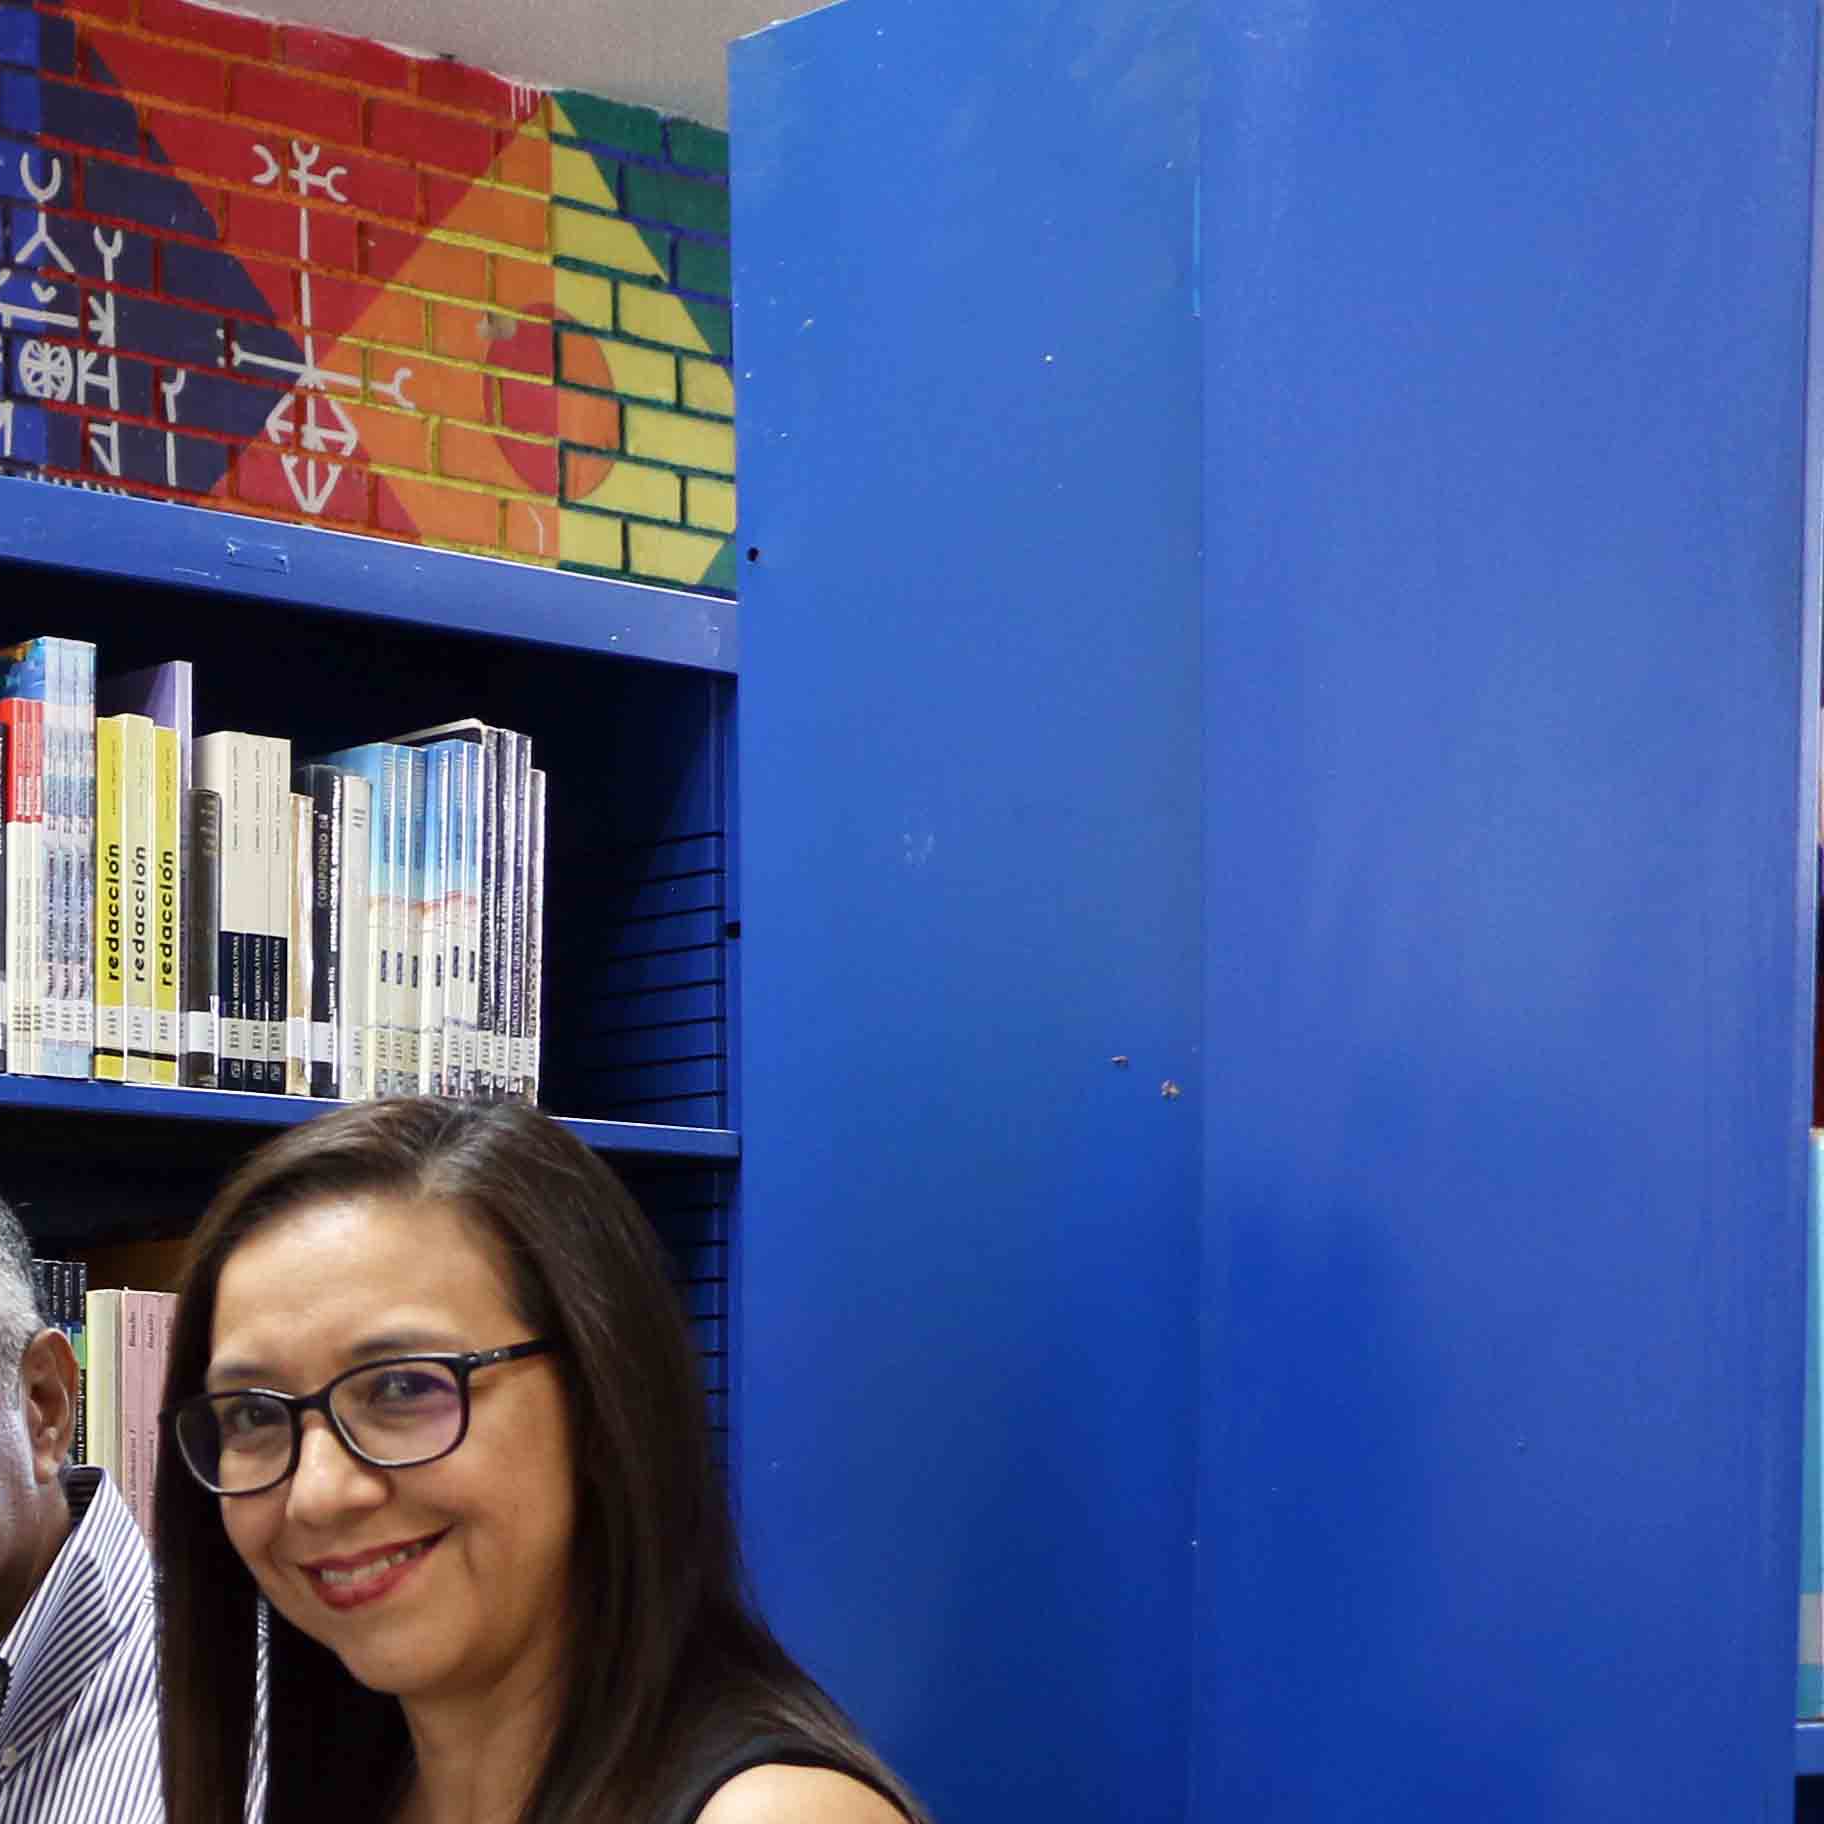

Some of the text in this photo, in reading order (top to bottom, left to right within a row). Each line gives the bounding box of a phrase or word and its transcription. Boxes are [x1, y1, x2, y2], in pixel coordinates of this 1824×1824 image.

[317, 832, 330, 909] COMPENDIO
[105, 843, 121, 981] redacción
[131, 846, 147, 983] redacción
[158, 850, 174, 987] redacción
[232, 935, 241, 999] GRECOLATINAS
[253, 938, 262, 1002] GRECOLATINAS
[272, 940, 281, 1003] GRECOLATINAS
